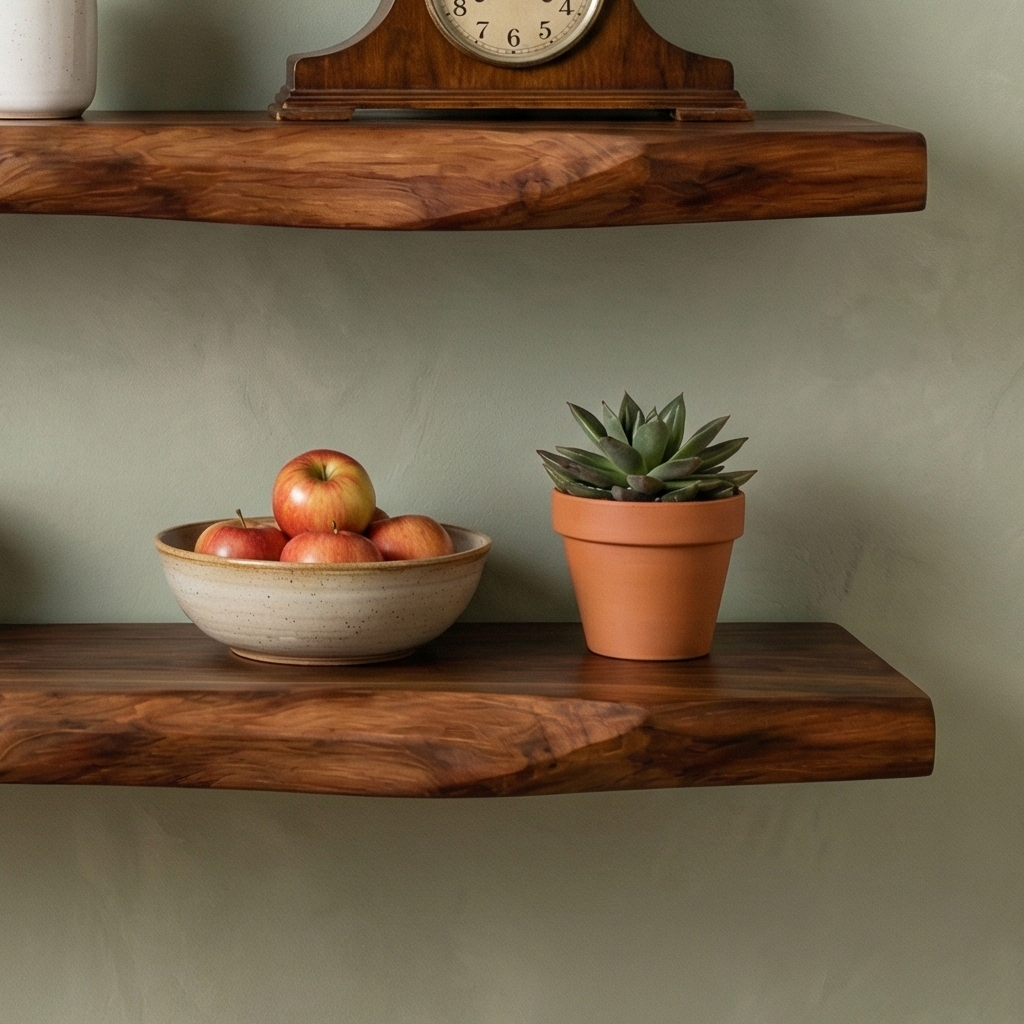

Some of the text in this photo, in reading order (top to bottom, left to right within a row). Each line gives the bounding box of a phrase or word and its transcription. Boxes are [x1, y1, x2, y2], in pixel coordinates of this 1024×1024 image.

[476, 21, 489, 39] 7
[507, 28, 521, 47] 6
[539, 21, 552, 39] 5
